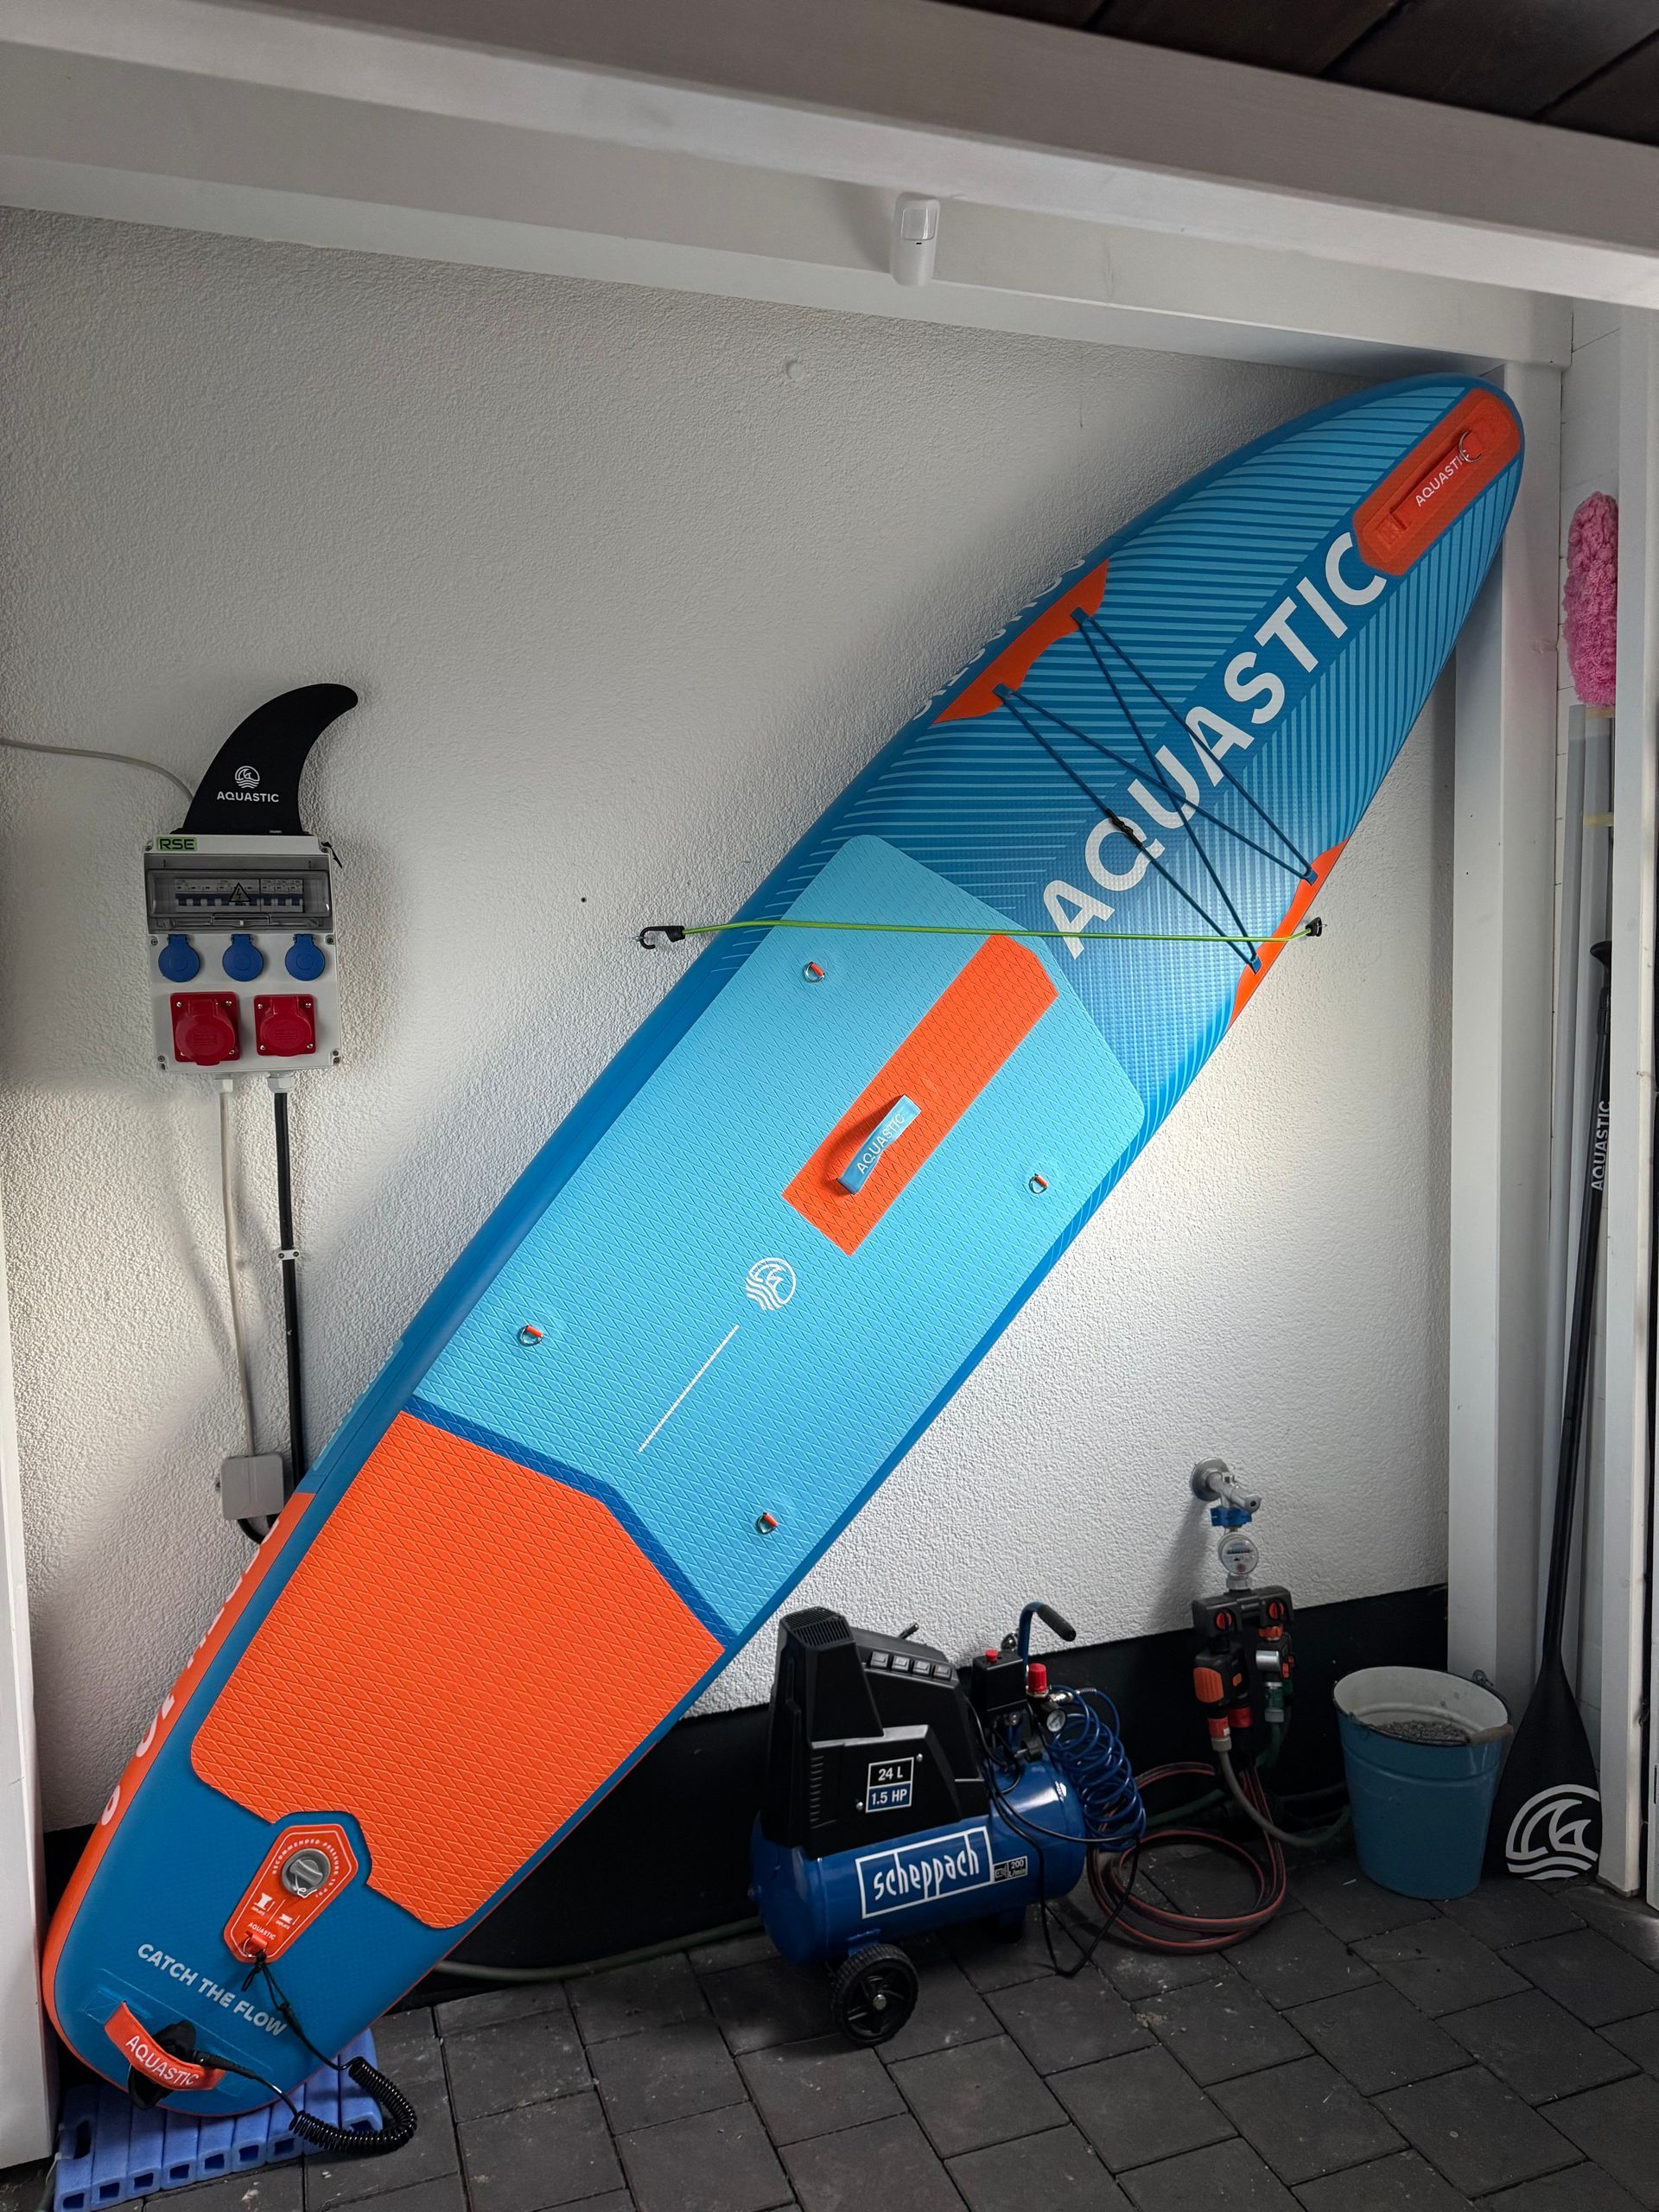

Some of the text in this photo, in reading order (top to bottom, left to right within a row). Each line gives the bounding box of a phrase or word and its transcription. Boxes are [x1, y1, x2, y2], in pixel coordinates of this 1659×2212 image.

[1043, 531, 1388, 959] AQUASTIC
[217, 791, 279, 803] AQUASTIC
[159, 838, 194, 850] RSE
[857, 1113, 905, 1174] AQUASTIC
[1591, 1100, 1609, 1191] AQUASTIC
[878, 1766, 904, 1781] 24 L
[872, 1789, 907, 1805] 1.5 HP
[272, 1839, 321, 1874] RECOMMENDED
[873, 1833, 980, 1900] scheppach
[1011, 1859, 1024, 1869] 200
[247, 1922, 276, 1941] AQUASTIC
[137, 1943, 289, 2036] CATCH THE FLOW
[125, 2035, 199, 2086] AQUASTIC
